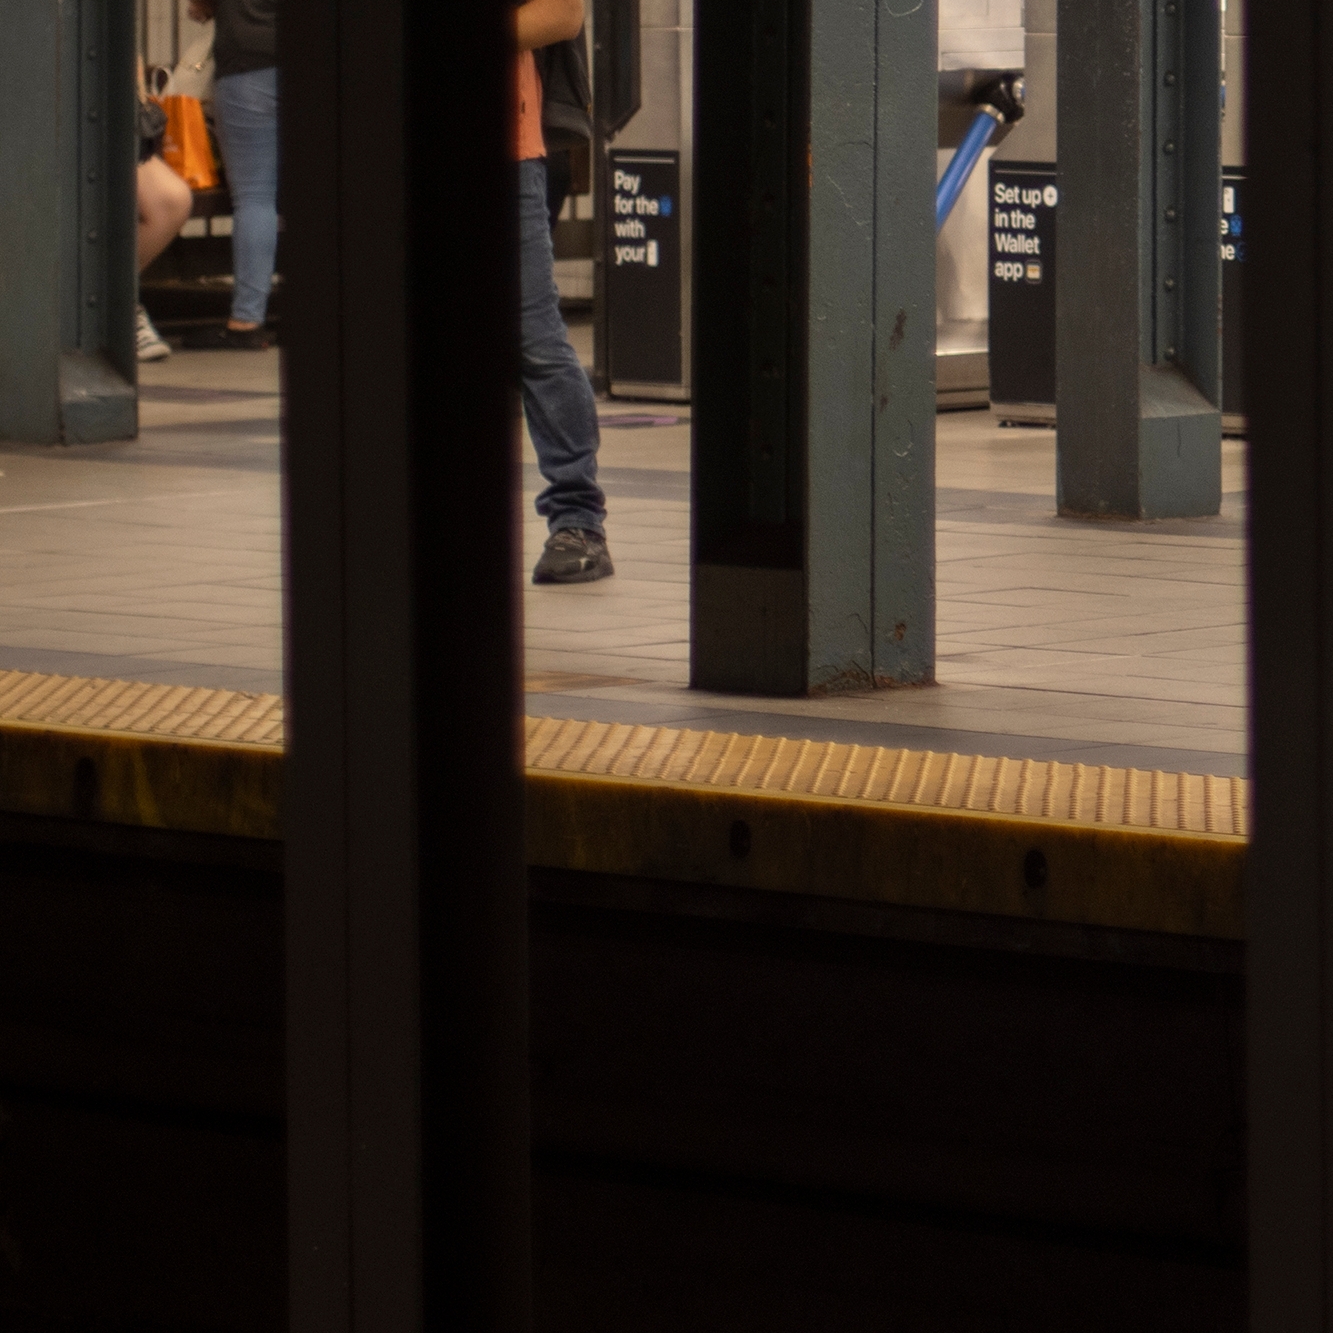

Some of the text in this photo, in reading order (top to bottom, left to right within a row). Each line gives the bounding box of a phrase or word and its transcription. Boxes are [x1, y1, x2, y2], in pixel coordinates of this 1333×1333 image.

[614, 169, 640, 195] Pay
[614, 194, 659, 215] for the
[994, 183, 1041, 208] Set up
[614, 218, 645, 238] with
[994, 208, 1035, 229] in the
[994, 233, 1040, 254] Wallet
[614, 245, 645, 266] your
[994, 261, 1023, 281] app
